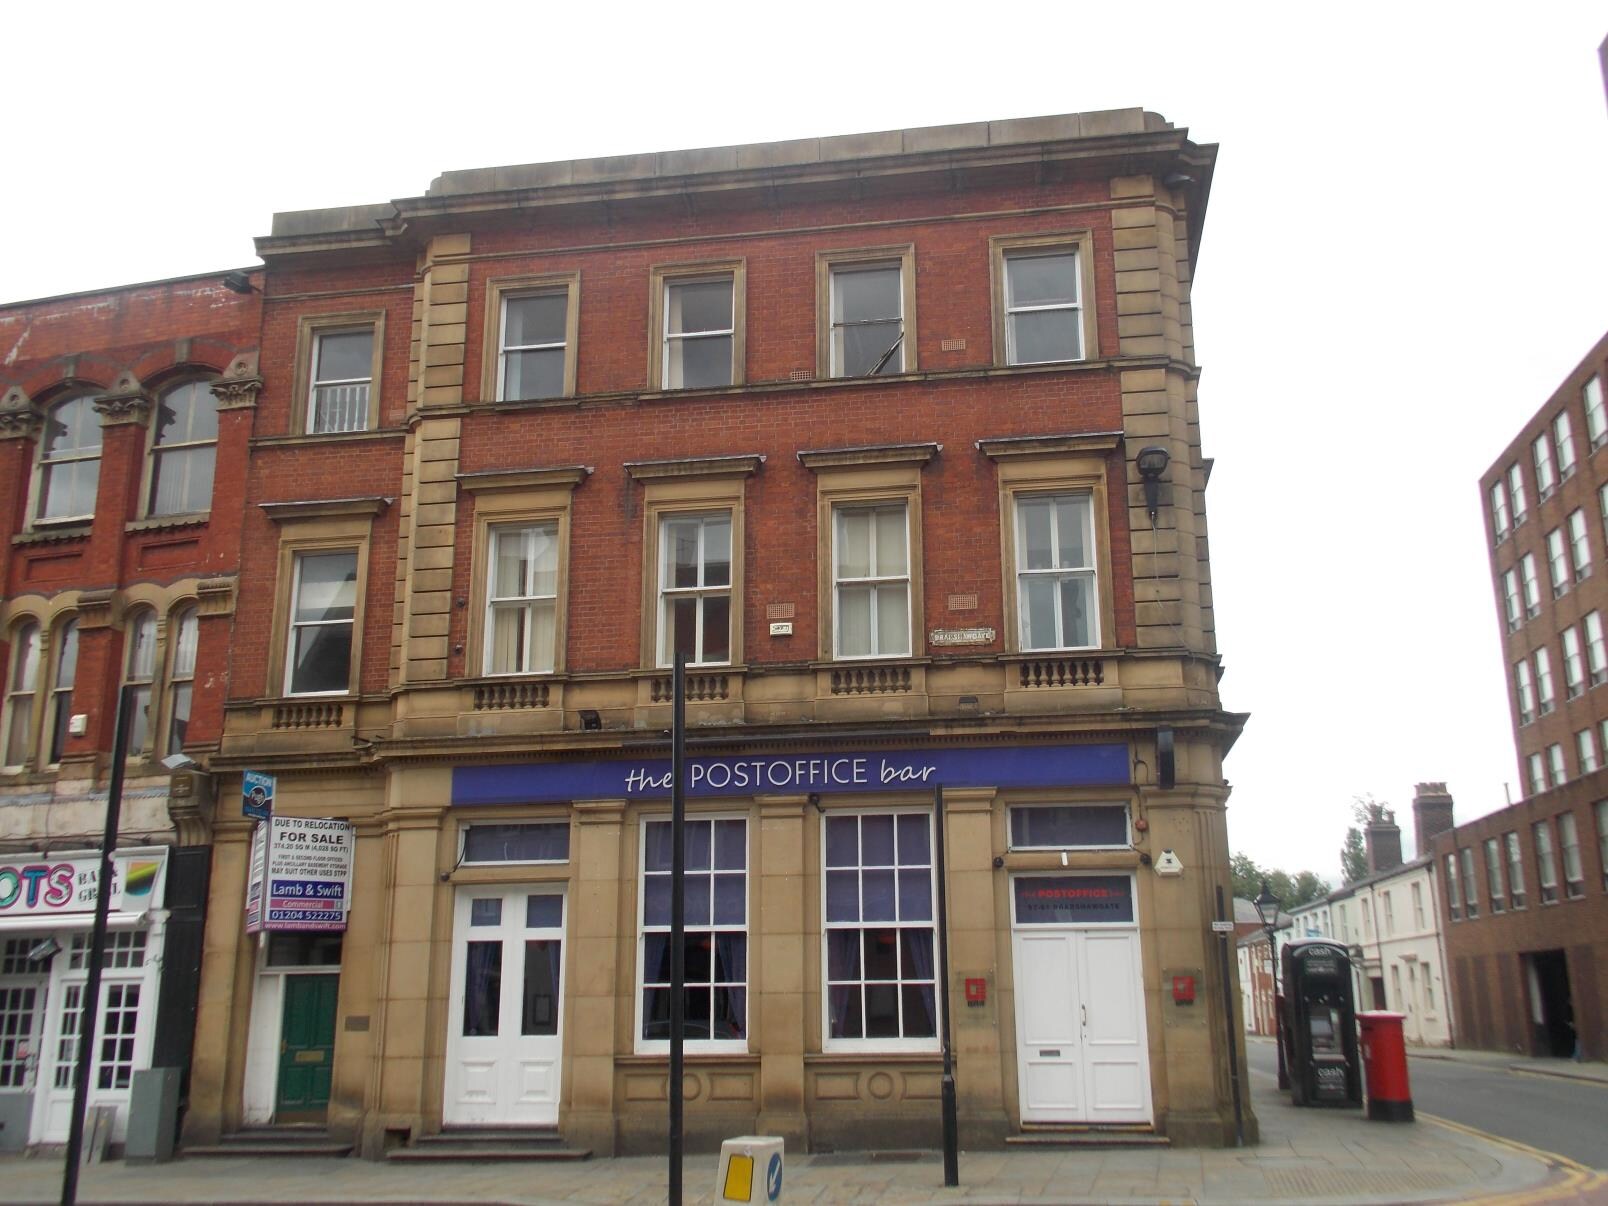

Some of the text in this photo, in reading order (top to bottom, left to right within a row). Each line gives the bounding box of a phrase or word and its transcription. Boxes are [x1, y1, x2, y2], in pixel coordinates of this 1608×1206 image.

[625, 759, 936, 792] the POSTOFFICE bar
[275, 818, 350, 831] DUE TO RELOCATION
[280, 831, 344, 845] FOR SALE
[272, 867, 284, 875] MAY
[300, 868, 318, 876] OTHER
[272, 883, 342, 897] Lamb & Swift
[1039, 889, 1108, 898] POSTOFFICE
[282, 900, 323, 908] Commercial
[271, 911, 341, 920] 01204 522275
